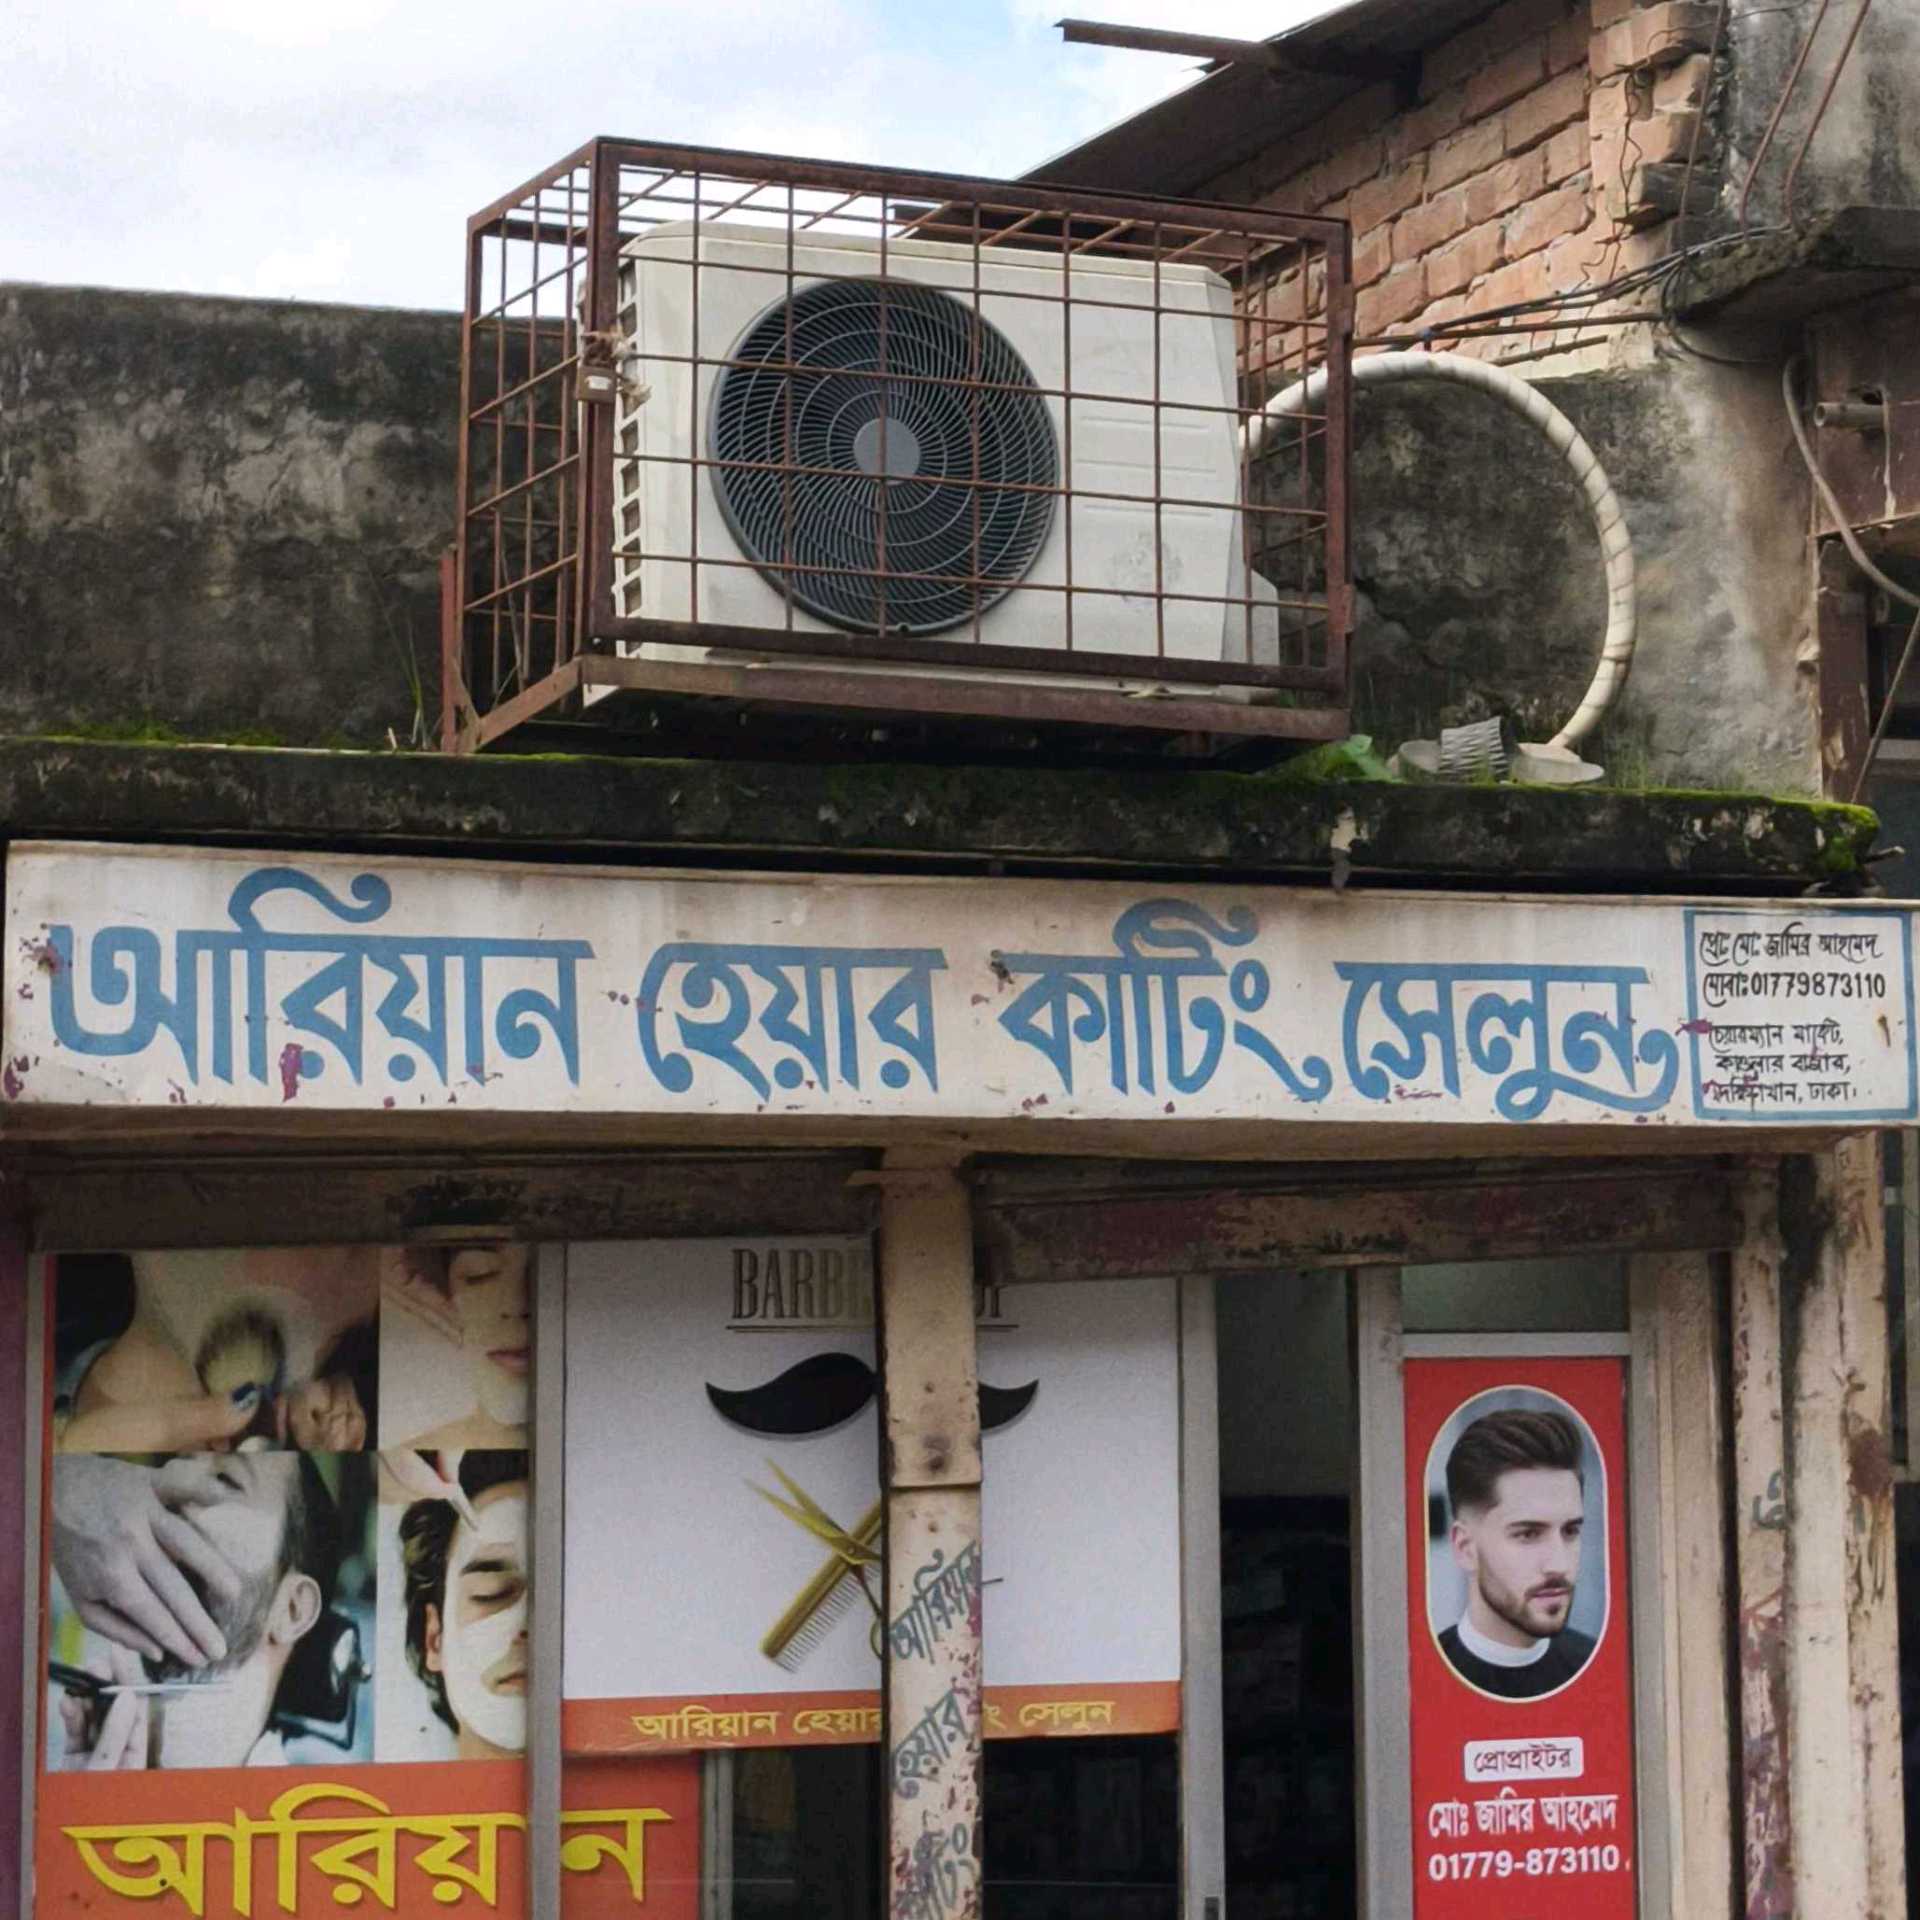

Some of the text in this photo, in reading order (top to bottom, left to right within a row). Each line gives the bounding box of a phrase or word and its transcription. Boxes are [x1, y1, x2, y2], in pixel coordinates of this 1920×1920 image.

[47, 866, 1679, 1122] আরিয়ান হেয়ার কাটিং সেলুন
[631, 1704, 780, 1741] আরিয়ান
[1018, 1700, 1117, 1730] সেলুন
[1474, 1786, 1536, 1835] জামির
